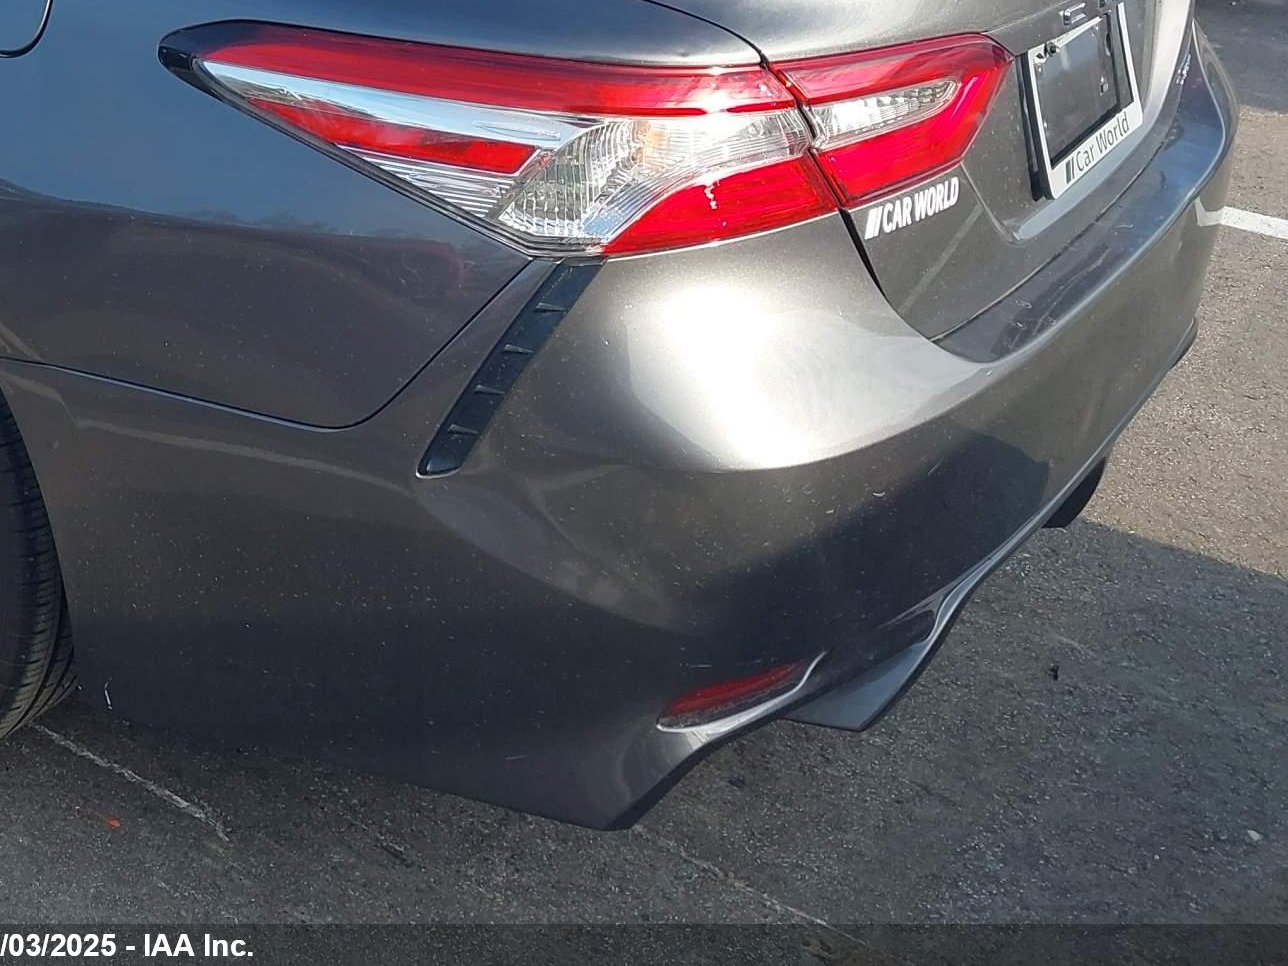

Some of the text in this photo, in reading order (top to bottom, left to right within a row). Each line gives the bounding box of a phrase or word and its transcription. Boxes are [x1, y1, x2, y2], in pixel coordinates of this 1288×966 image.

[1076, 111, 1130, 172] Car World
[883, 176, 959, 233] CAR WORLD
